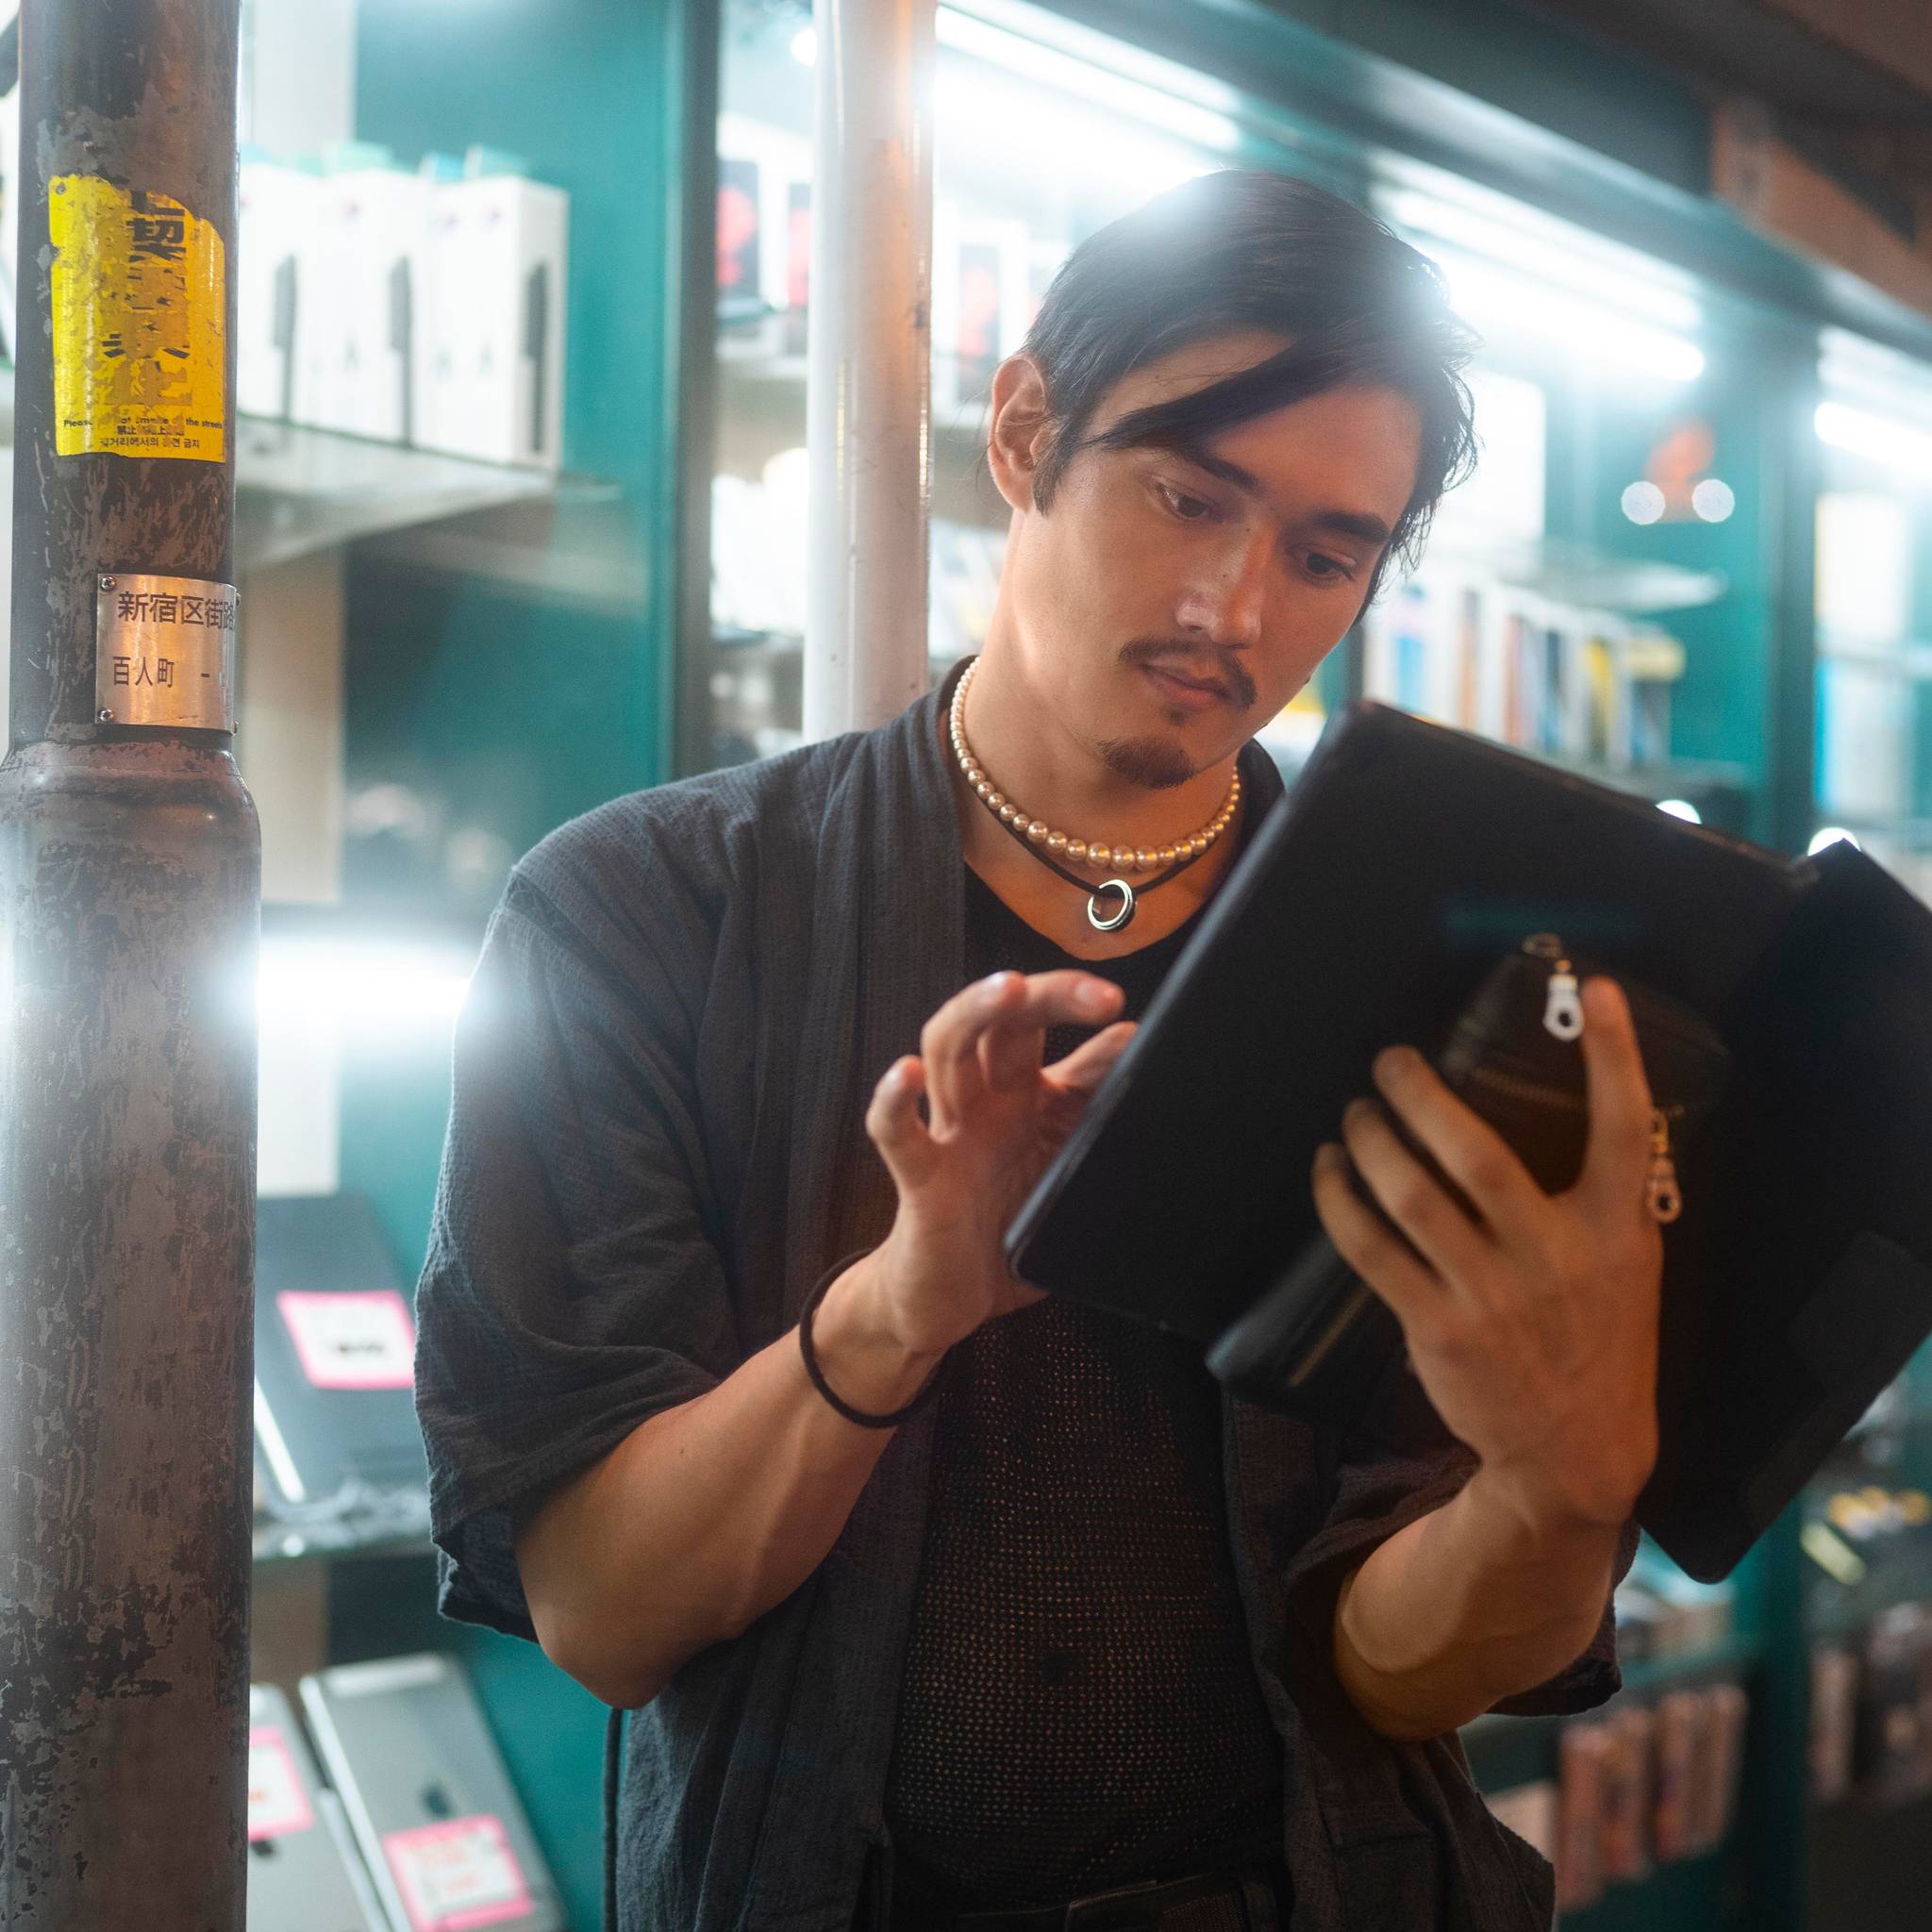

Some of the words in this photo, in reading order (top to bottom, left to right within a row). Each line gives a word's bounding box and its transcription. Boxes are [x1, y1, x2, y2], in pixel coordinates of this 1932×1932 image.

[185, 417, 199, 427] the
[112, 656, 175, 688] 百人町
